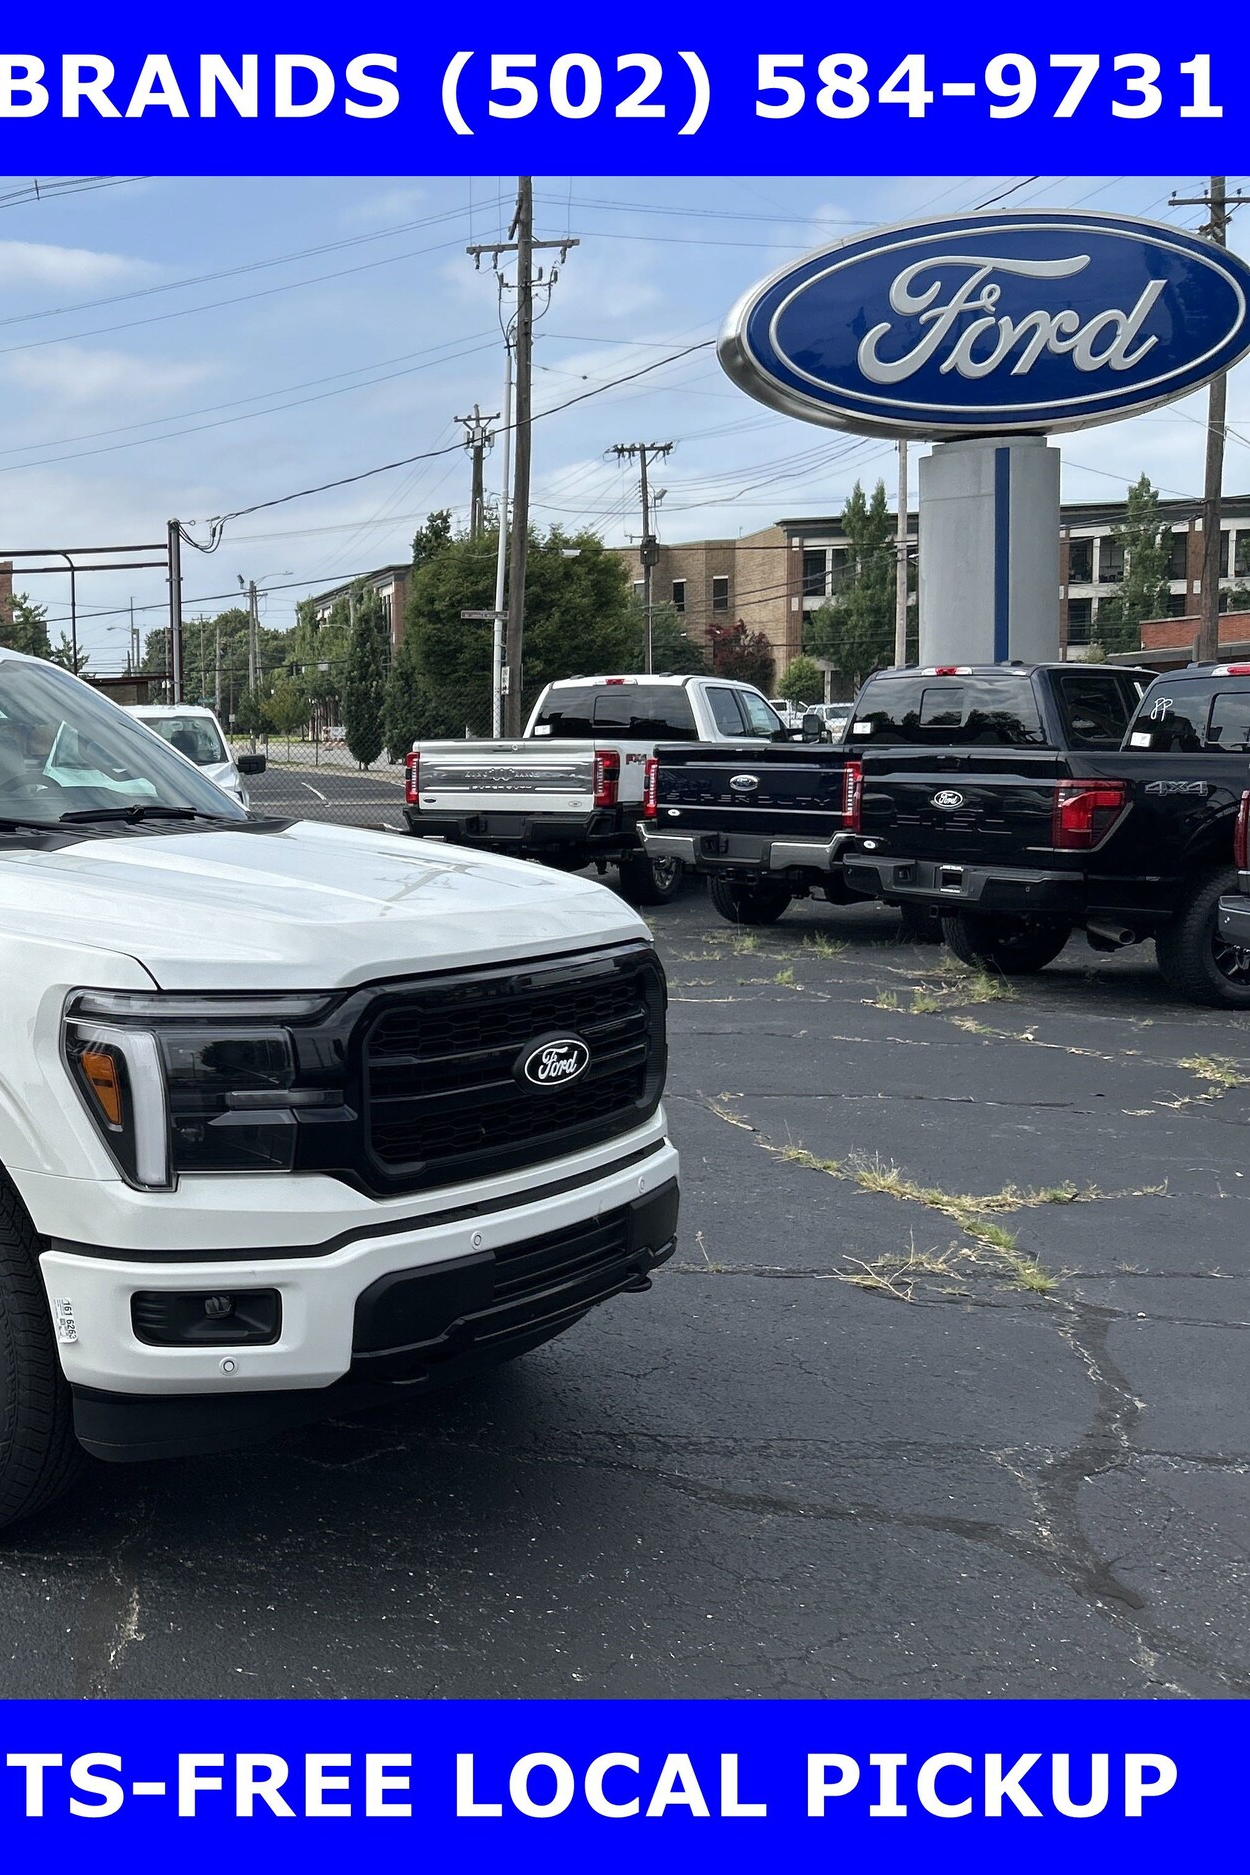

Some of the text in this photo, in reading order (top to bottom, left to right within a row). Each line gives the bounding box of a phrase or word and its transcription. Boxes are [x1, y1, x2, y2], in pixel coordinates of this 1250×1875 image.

[857, 254, 1168, 384] Ford
[938, 793, 958, 805] Ford
[537, 1046, 578, 1080] Ford
